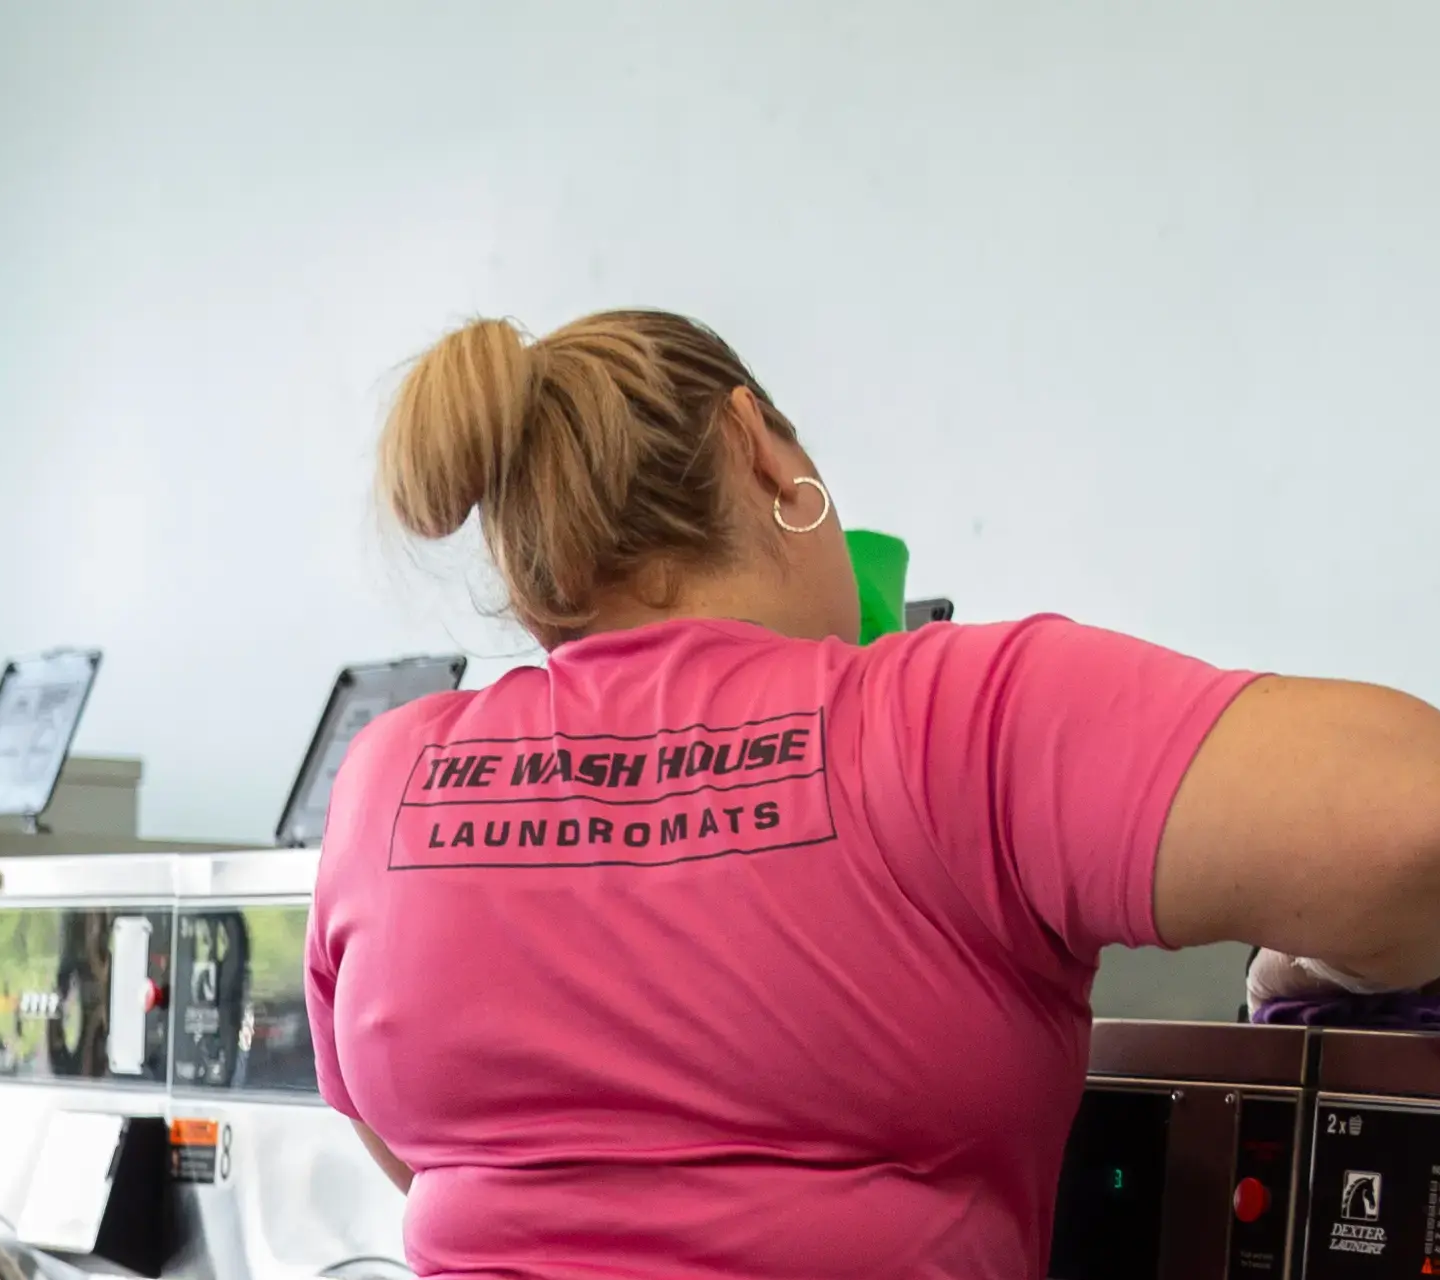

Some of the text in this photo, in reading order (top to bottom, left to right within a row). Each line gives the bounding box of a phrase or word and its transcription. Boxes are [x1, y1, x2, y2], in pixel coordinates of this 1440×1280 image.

[422, 729, 809, 790] THE WASH HOUSE
[428, 801, 780, 848] LAUNDROMATS
[1327, 1113, 1337, 1134] 2
[220, 1123, 233, 1181] 8
[1329, 1239, 1386, 1255] LAUNDRY
[1330, 1223, 1385, 1241] DEXTER
